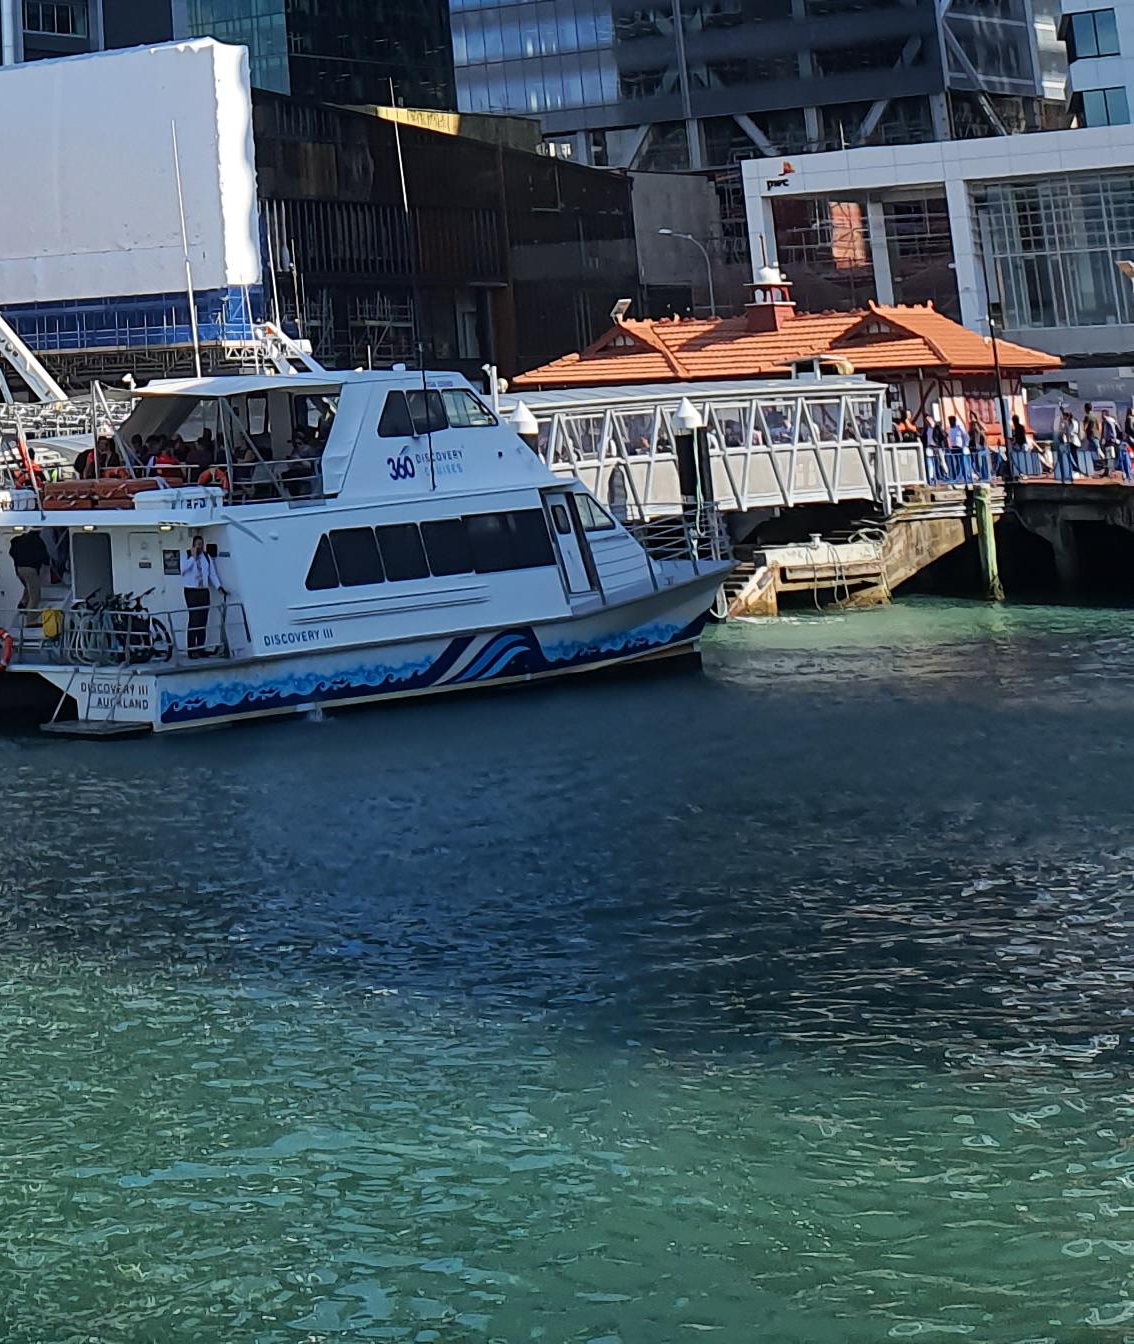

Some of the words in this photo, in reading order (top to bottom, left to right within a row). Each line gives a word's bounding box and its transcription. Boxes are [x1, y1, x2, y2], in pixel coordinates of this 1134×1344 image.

[387, 446, 415, 480] 360
[263, 629, 320, 647] DISCOVERY
[322, 627, 334, 639] III
[138, 684, 150, 696] III
